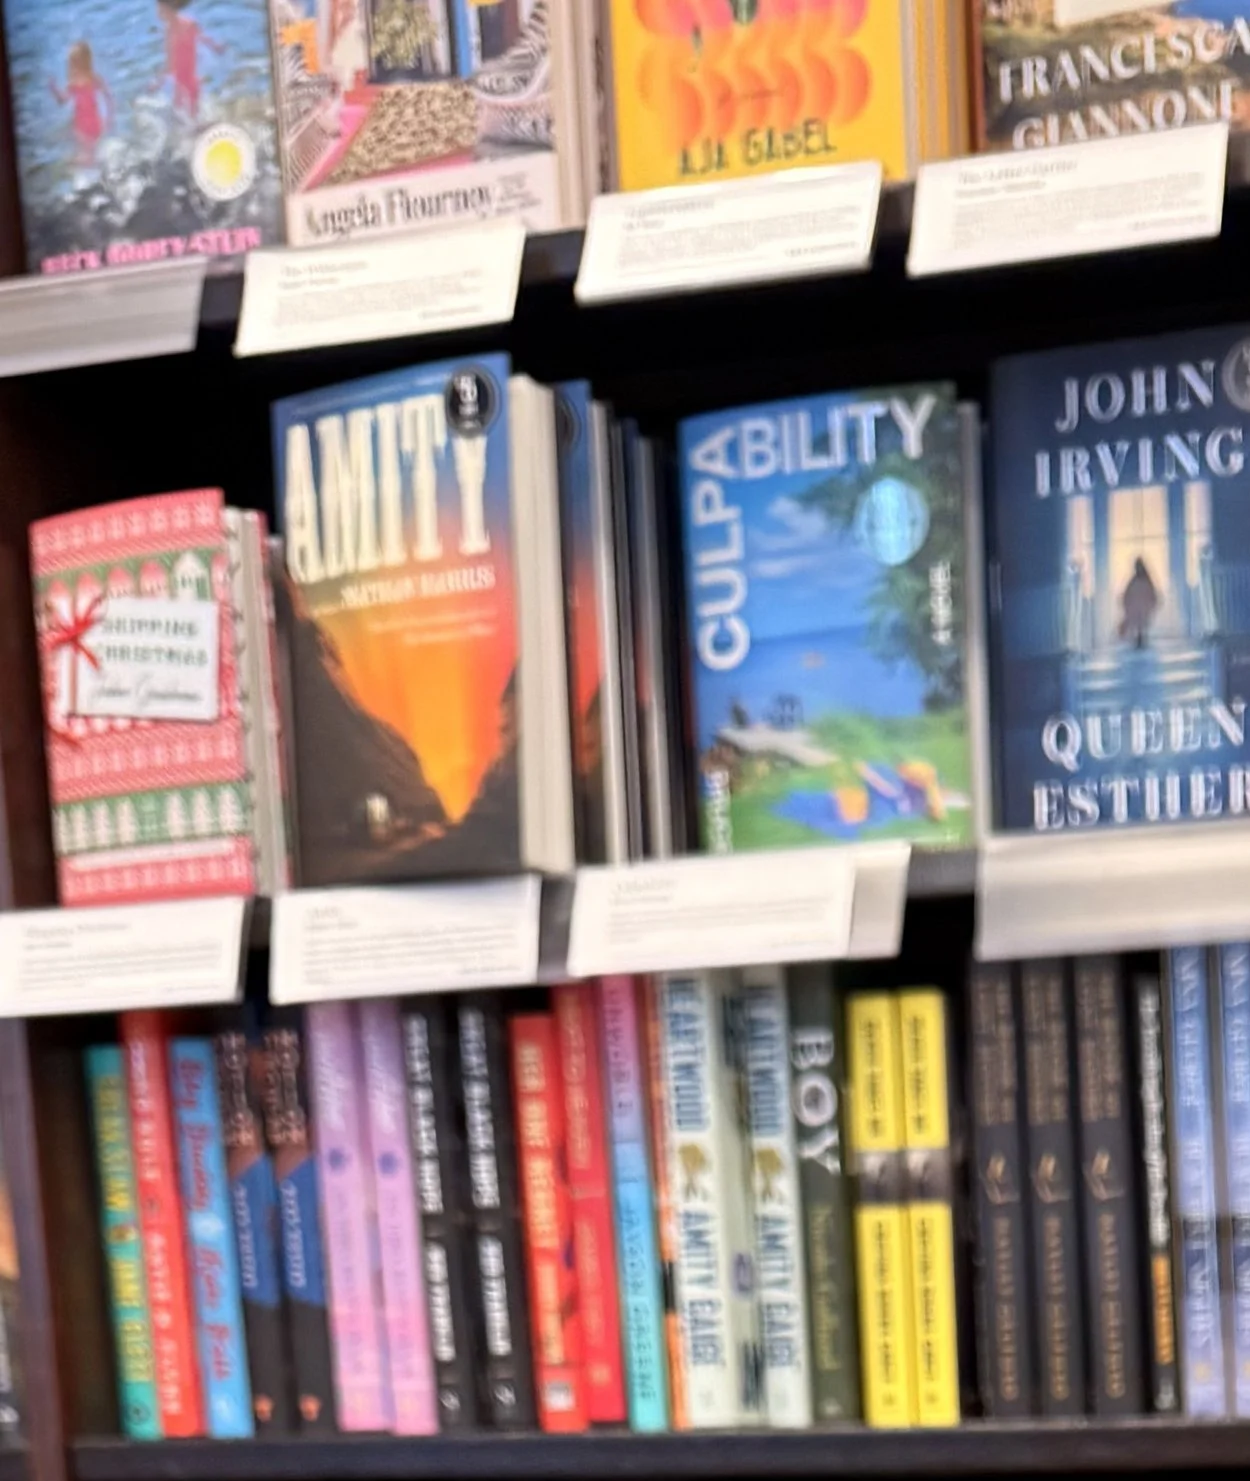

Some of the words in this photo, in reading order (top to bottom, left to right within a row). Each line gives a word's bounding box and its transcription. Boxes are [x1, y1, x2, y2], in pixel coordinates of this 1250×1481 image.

[681, 136, 729, 176] AJA
[741, 117, 837, 167] GABEL
[306, 192, 383, 236] Angela
[1055, 360, 1217, 433] JOHN
[286, 393, 491, 584] AMITY
[1036, 427, 1246, 499] IRVING
[1042, 698, 1248, 771] QUEEN
[790, 1026, 841, 1175] BOY
[681, 1210, 715, 1288] AMITY
[756, 1215, 793, 1290] AMITY
